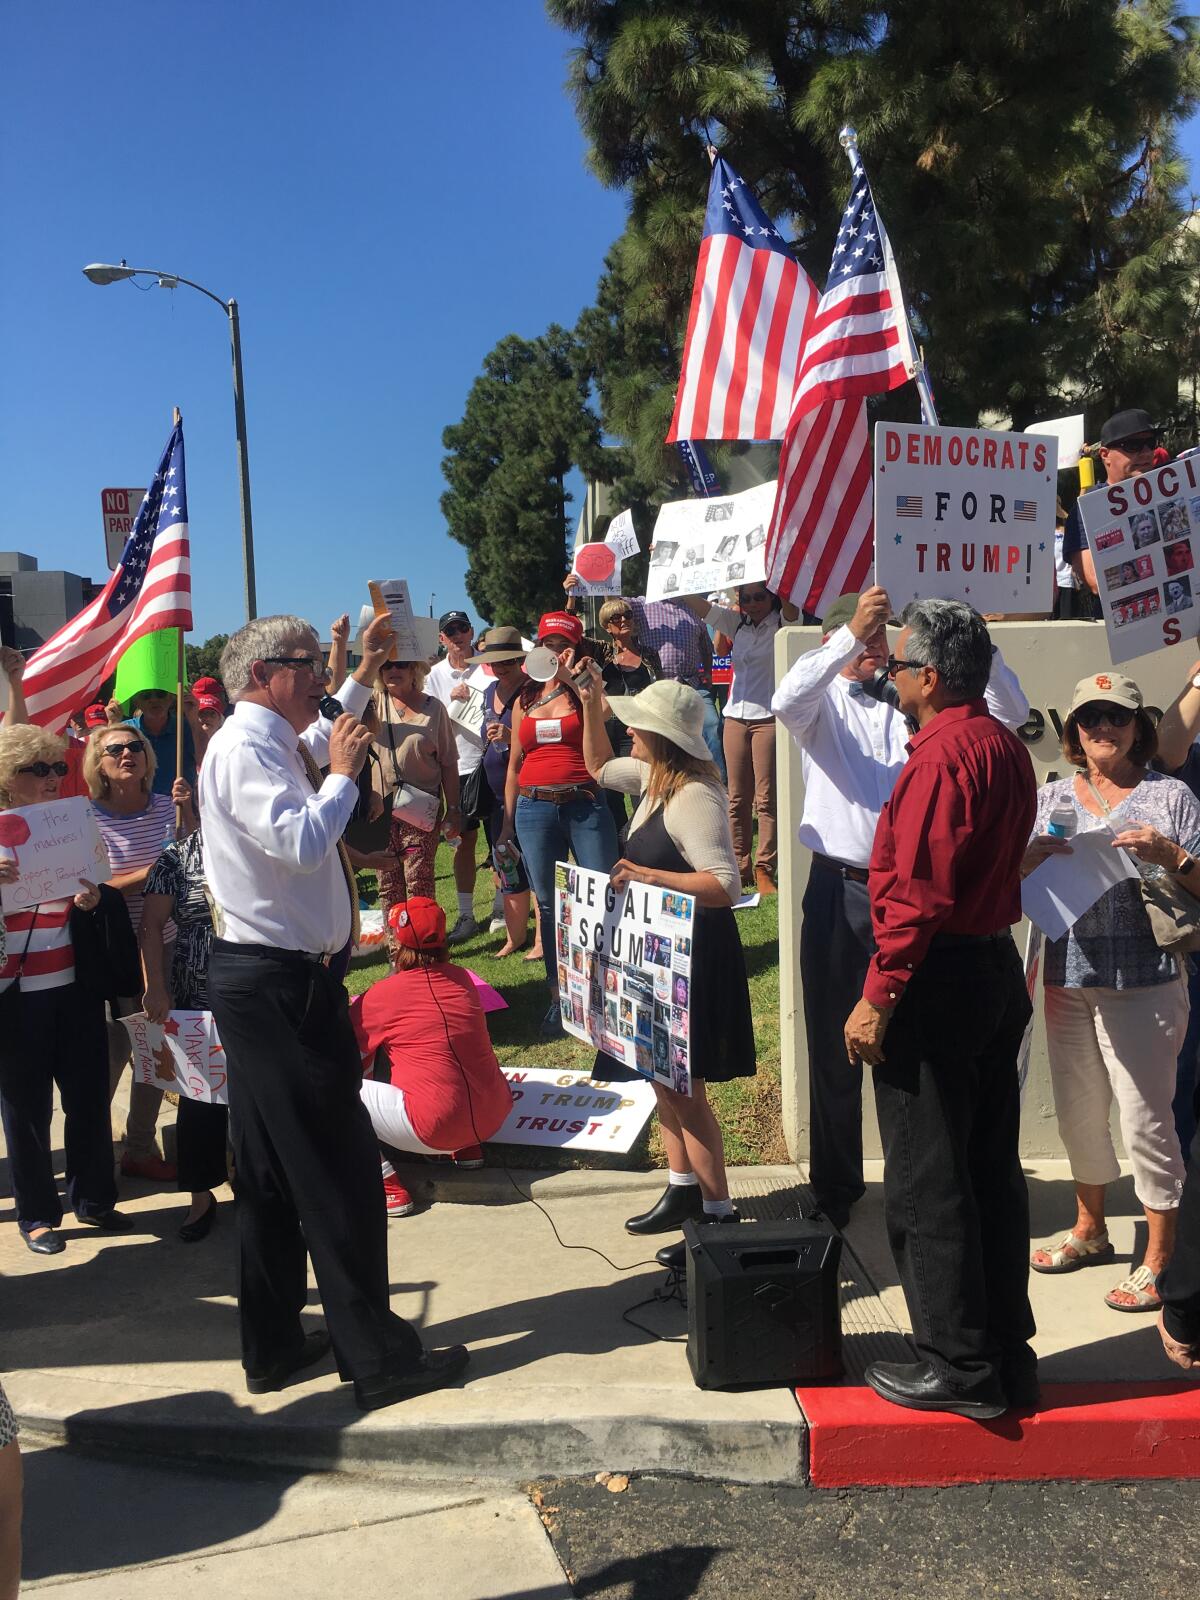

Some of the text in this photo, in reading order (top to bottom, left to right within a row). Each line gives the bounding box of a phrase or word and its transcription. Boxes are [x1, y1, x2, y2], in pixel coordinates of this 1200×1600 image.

[885, 430, 1047, 473] DEMOCRATS
[106, 492, 126, 512] NO
[934, 491, 1007, 524] FOR
[915, 542, 1032, 585] TRUMP!
[1162, 617, 1182, 646] S
[712, 658, 731, 667] NCE
[42, 808, 70, 829] the
[13, 880, 55, 903] OUR
[575, 874, 652, 925] LEGAL
[579, 917, 644, 968] SCUM
[185, 1017, 205, 1069] MAKE
[556, 1074, 612, 1089] GOD
[540, 1093, 635, 1111] TRUMP
